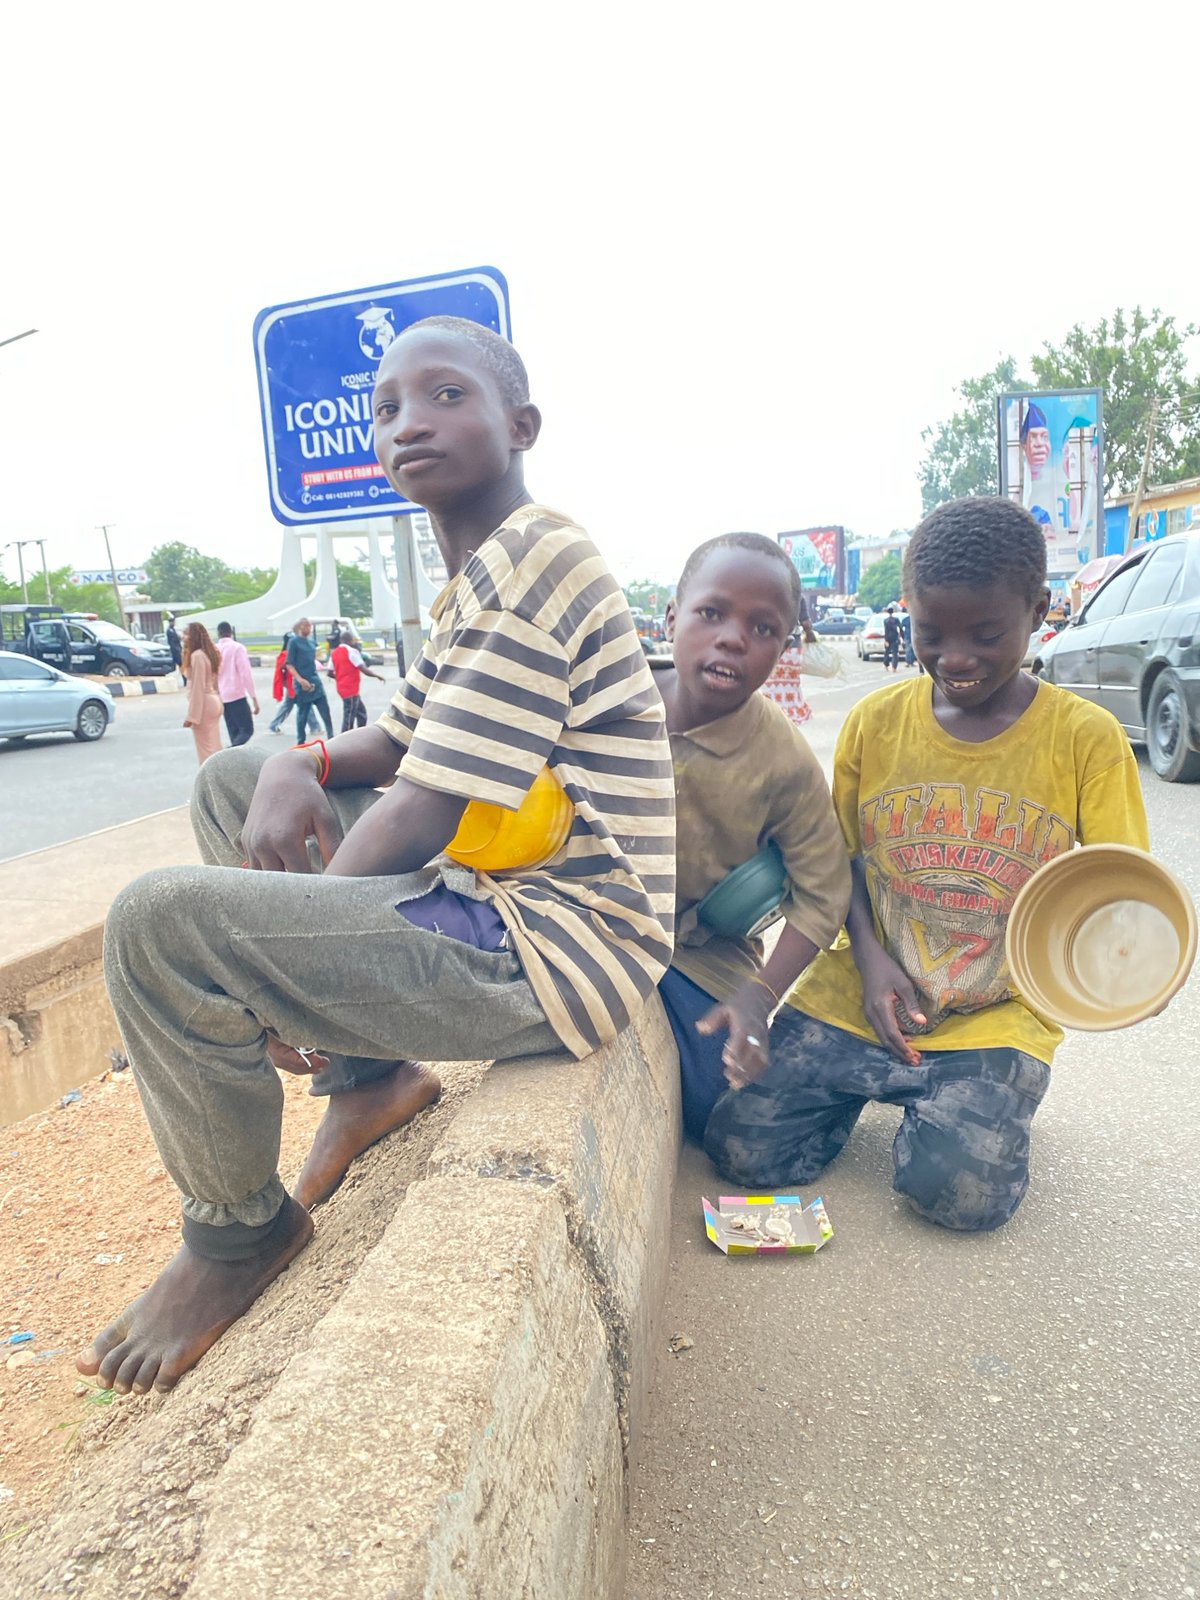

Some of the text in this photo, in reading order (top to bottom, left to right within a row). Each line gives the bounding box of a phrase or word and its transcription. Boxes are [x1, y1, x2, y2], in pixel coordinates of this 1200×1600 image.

[340, 371, 370, 387] ICONIC
[284, 392, 372, 432] ICONI
[303, 472, 324, 485] STUDY
[325, 470, 344, 482] WITH
[344, 469, 353, 480] US
[353, 467, 373, 479] FROM
[82, 573, 137, 583] NASCO
[860, 783, 1075, 863] ITALIA
